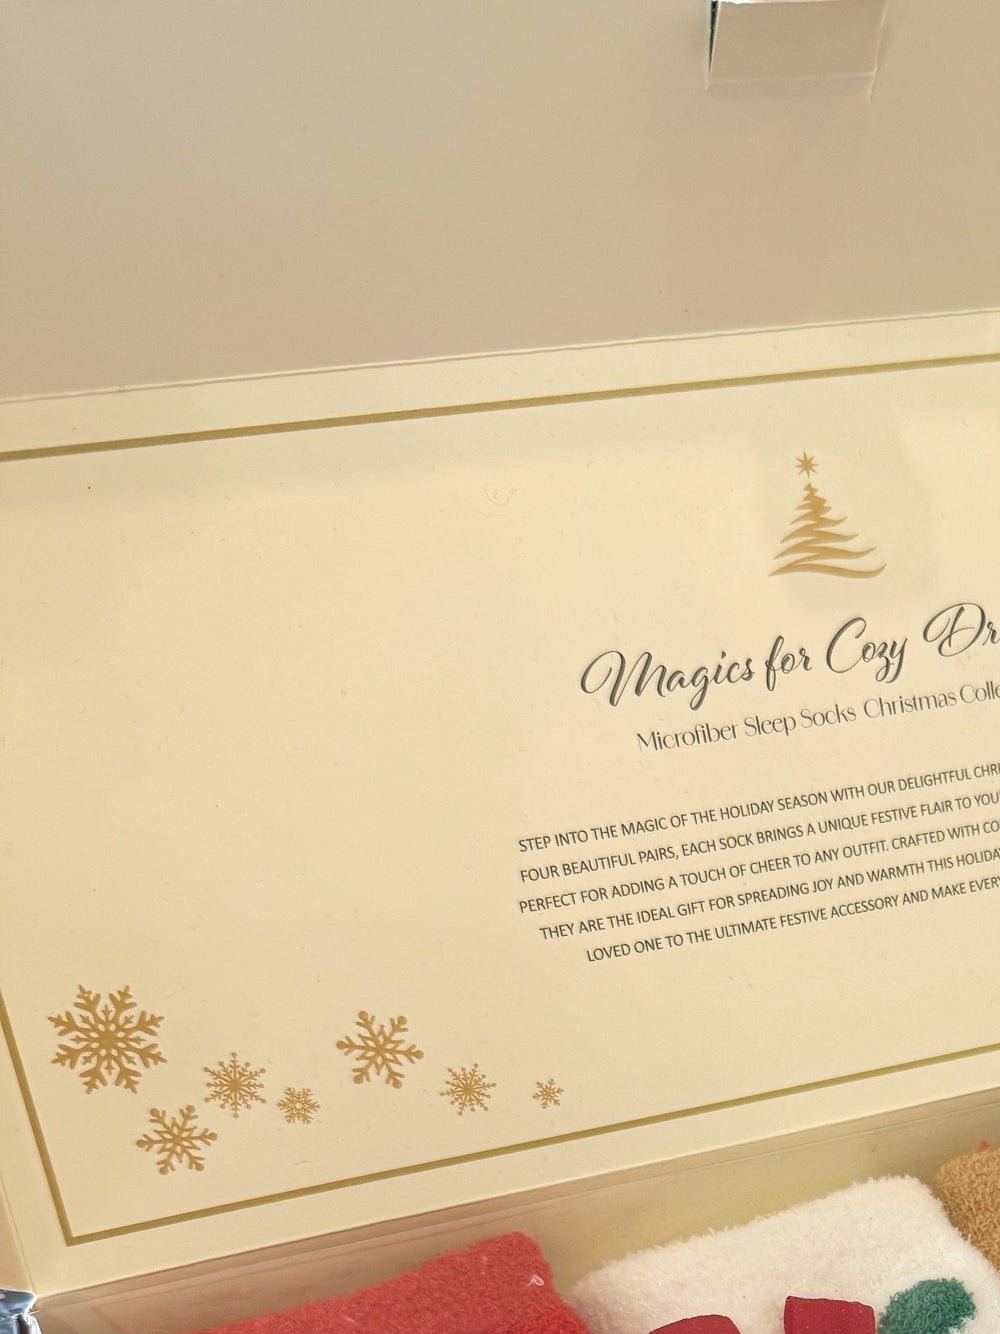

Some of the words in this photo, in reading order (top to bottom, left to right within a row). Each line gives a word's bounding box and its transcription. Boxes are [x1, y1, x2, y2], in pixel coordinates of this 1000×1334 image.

[580, 650, 756, 712] Magics
[764, 634, 813, 693] for
[825, 616, 909, 684] Cozy
[636, 722, 739, 752] Microfiber
[743, 715, 797, 737] Sleep
[799, 703, 857, 729] Socks
[863, 691, 958, 719] Christmas
[518, 835, 552, 853] STEP
[553, 829, 589, 848] INTO
[589, 824, 619, 841] THE
[620, 816, 669, 837] MAGIC
[669, 813, 689, 829] OF
[689, 808, 718, 825] THE
[719, 799, 775, 821] HOLIDAY
[777, 791, 829, 812] SEASON
[829, 785, 866, 803] WITH
[867, 780, 897, 797] OUR
[897, 768, 973, 792] DELIGHTFUL
[519, 864, 561, 884] FOUR
[561, 852, 637, 877] BEAUTIFUL
[638, 845, 680, 865] PAIRS,
[680, 838, 717, 857] EACH
[718, 832, 755, 851] SOCK
[755, 824, 804, 845] BRINGS
[806, 822, 817, 837] A
[817, 813, 870, 834] UNIQUE
[870, 805, 919, 825] FESTIVE
[919, 799, 954, 817] FLAIR
[953, 796, 972, 811] TO
[518, 891, 578, 914] PERFECT
[579, 887, 610, 904] FOR
[610, 877, 666, 899] ADDING
[668, 875, 679, 889] A
[678, 866, 727, 887] TOUCH
[728, 863, 747, 879] OF
[749, 856, 792, 875] CHEER
[792, 852, 812, 867] TO
[814, 847, 840, 864] ANY
[842, 839, 890, 859] OUTFIT.
[890, 829, 946, 851] CRAFTED
[946, 823, 981, 841] WITH
[538, 922, 575, 941] THEY
[578, 917, 606, 935] ARE
[605, 912, 635, 929] THE
[636, 905, 677, 925] IDEAL
[676, 899, 706, 917] GIFT
[707, 895, 736, 912] FOR
[736, 881, 810, 907] SPREADING
[812, 877, 834, 894] JOY
[837, 872, 865, 889] AND
[865, 861, 926, 884] WARMTH
[925, 856, 955, 873] THIS
[586, 943, 632, 963] LOVED
[633, 937, 664, 954] ONE
[663, 933, 684, 948] TO
[684, 928, 713, 945] THE
[714, 916, 778, 940] ULTIMATE
[779, 907, 829, 928] FESTIVE
[830, 893, 899, 919] ACCESSORY
[902, 889, 929, 906] AND
[930, 882, 968, 900] MAKE
